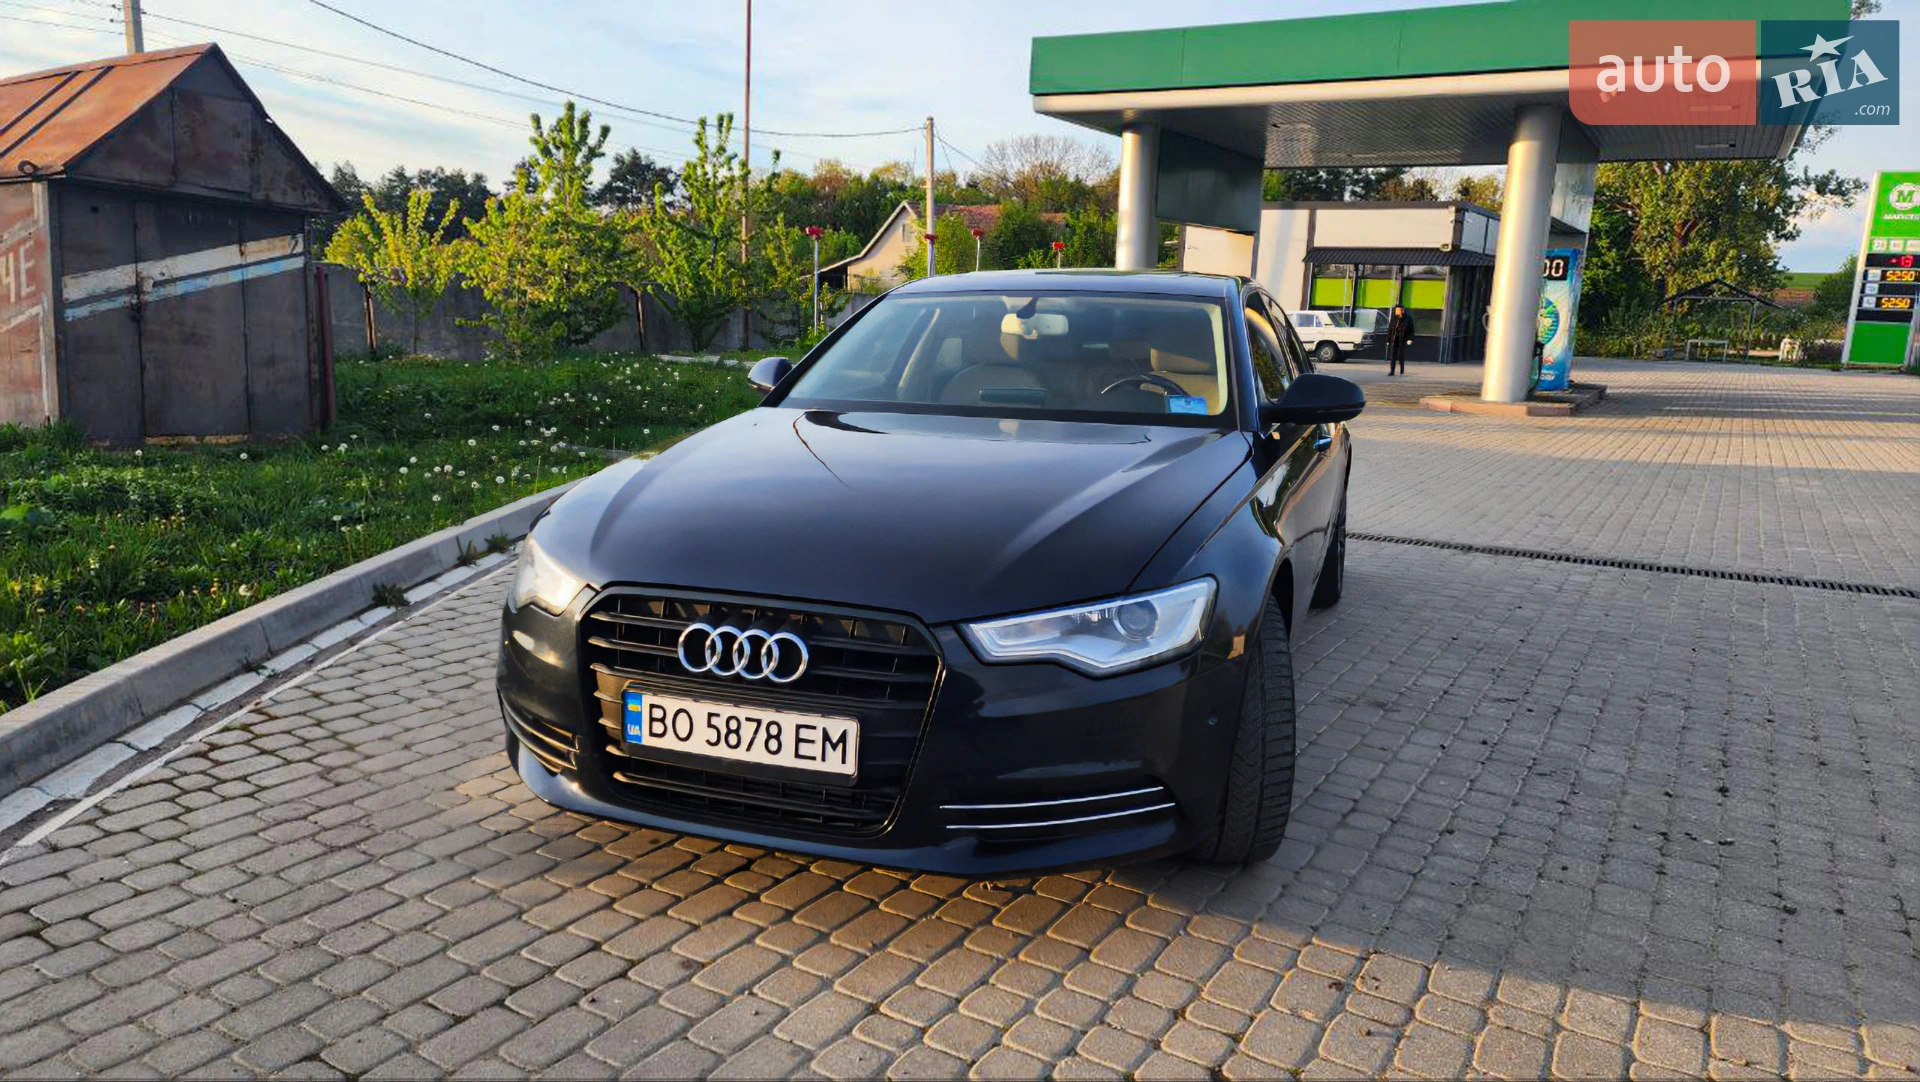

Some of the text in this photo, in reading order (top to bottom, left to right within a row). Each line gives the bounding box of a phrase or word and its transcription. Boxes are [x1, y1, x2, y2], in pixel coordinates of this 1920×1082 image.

[627, 724, 642, 736] UA
[649, 703, 848, 765] BO 5878 EM
